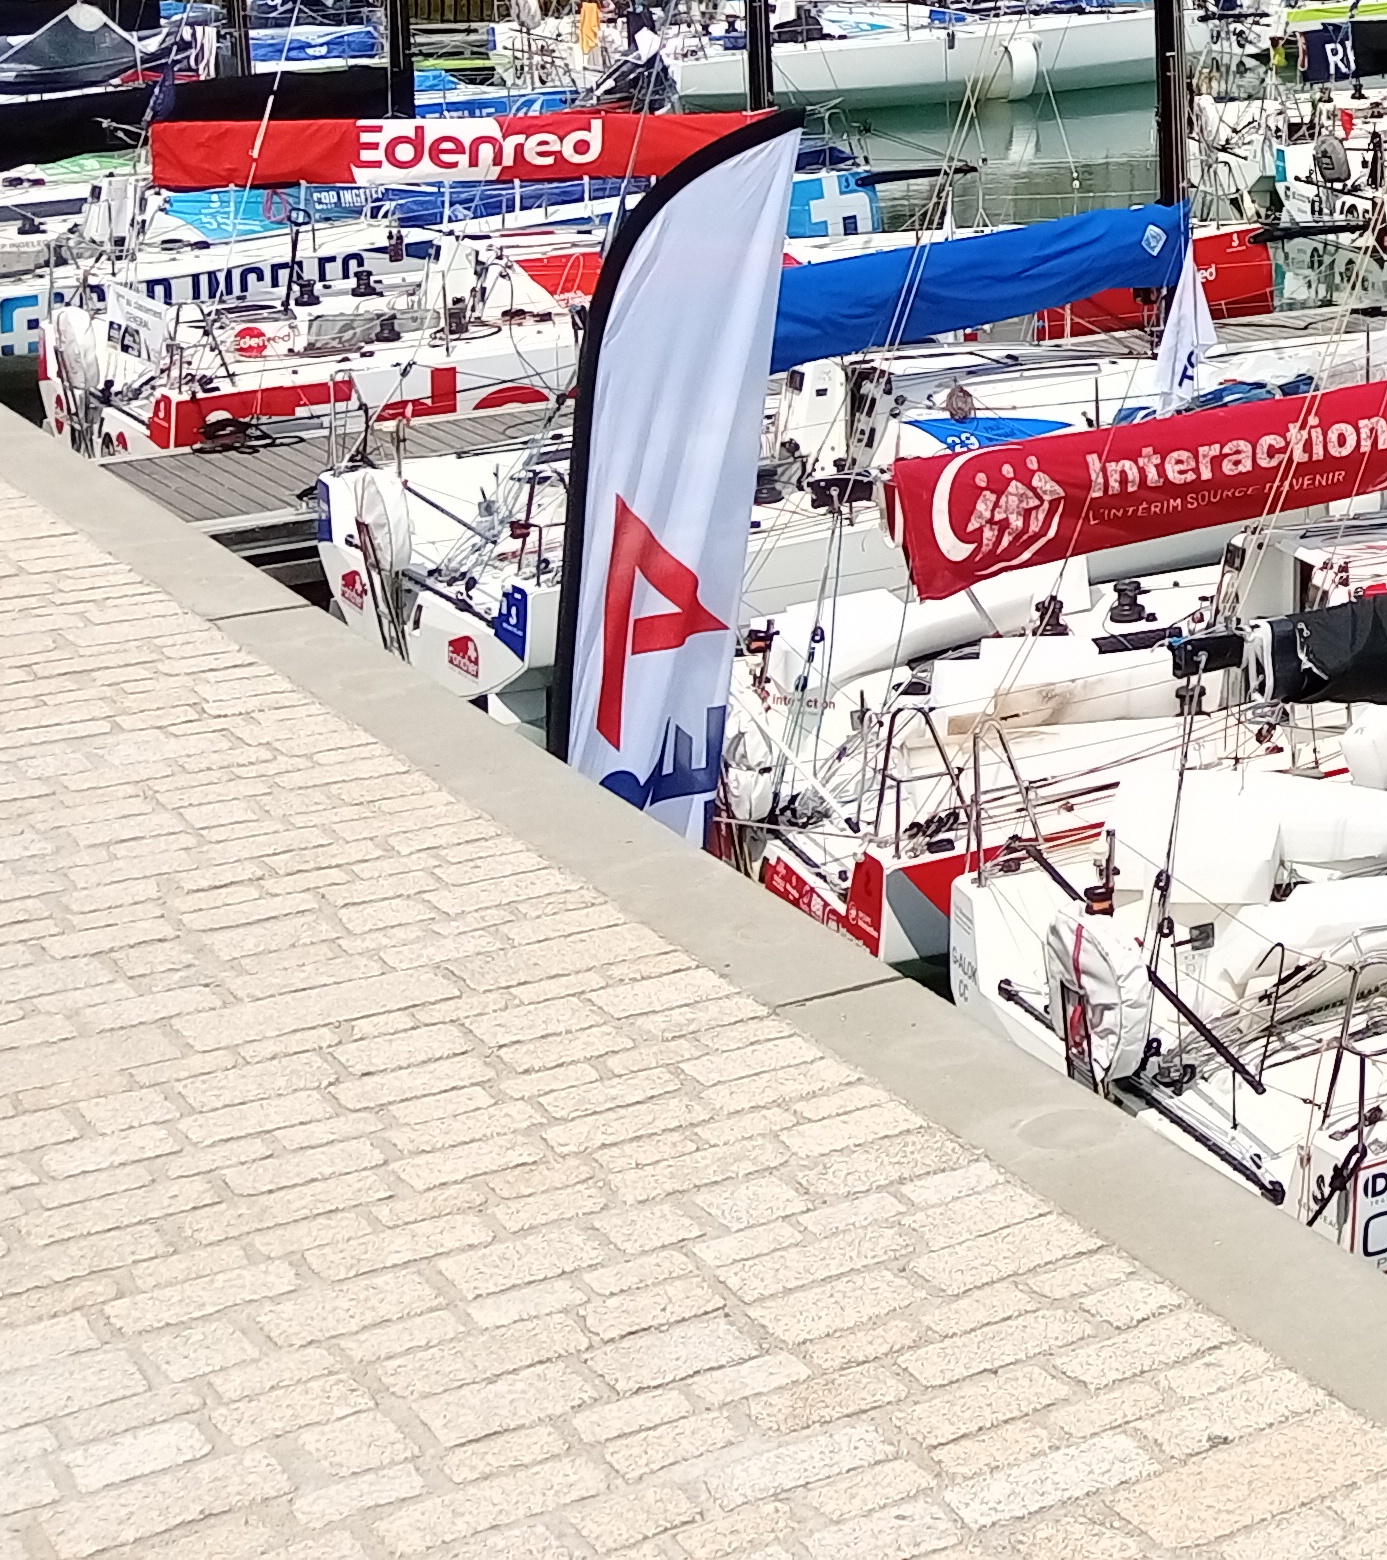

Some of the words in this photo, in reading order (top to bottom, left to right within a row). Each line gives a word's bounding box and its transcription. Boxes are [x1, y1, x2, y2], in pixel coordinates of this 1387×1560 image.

[356, 118, 604, 169] Edenred
[233, 331, 291, 349] Edenred
[1088, 496, 1183, 526] L'INTÉRIM
[1186, 484, 1260, 509] SOURCE
